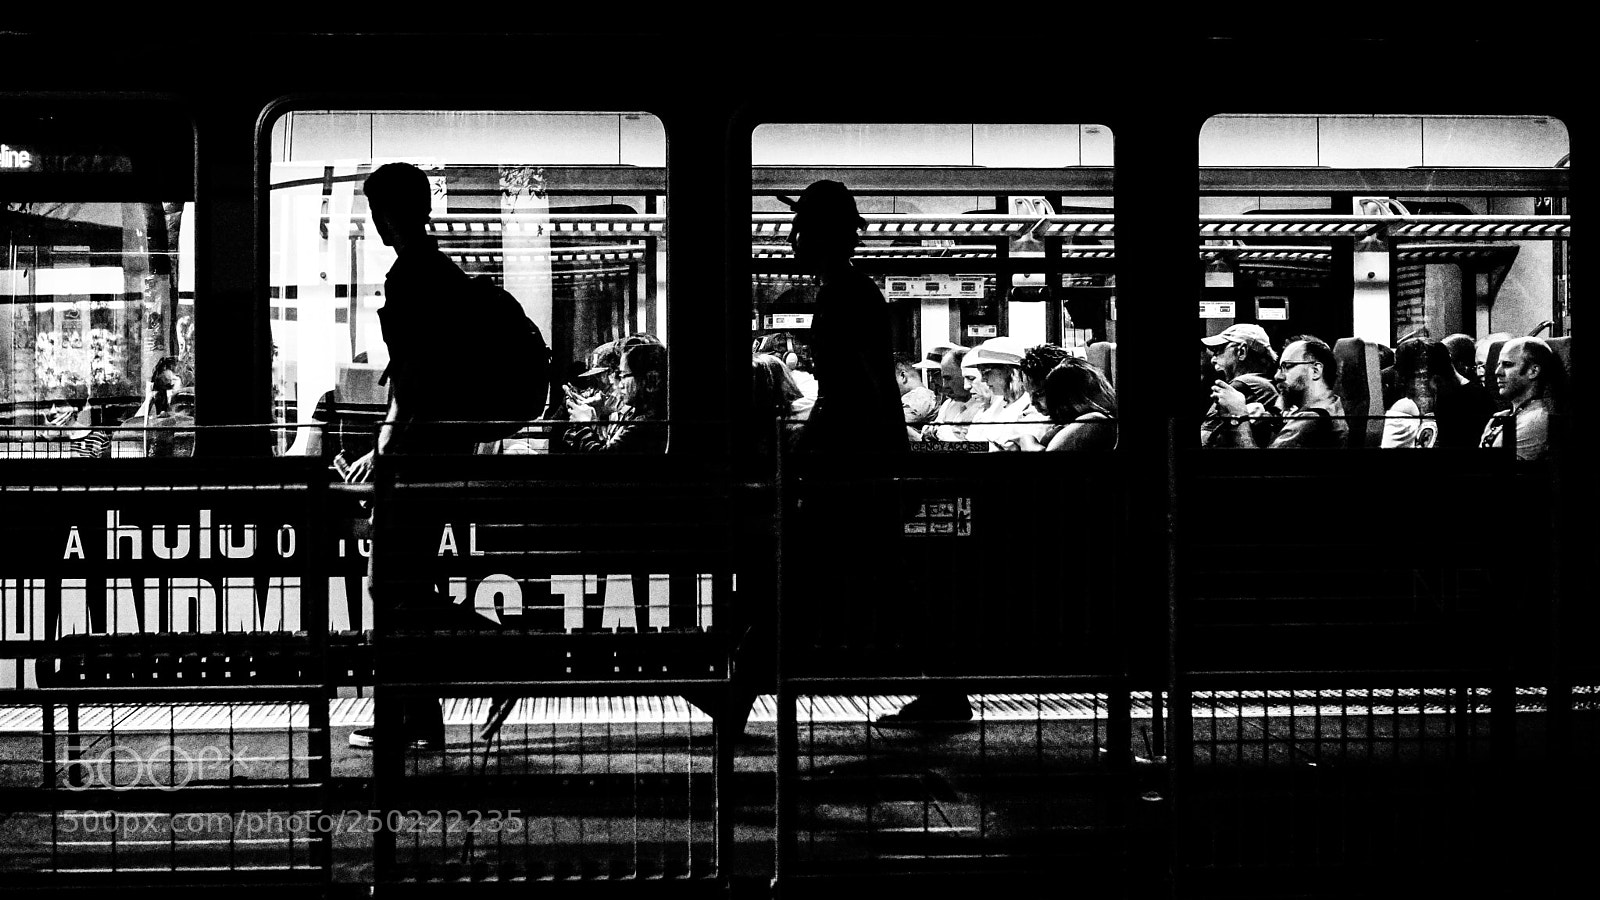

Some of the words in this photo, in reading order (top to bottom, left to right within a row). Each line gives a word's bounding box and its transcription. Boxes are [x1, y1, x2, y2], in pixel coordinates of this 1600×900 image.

[0, 144, 33, 168] line
[63, 526, 85, 559] A
[106, 509, 257, 560] hulu
[277, 522, 485, 558] OIGAL
